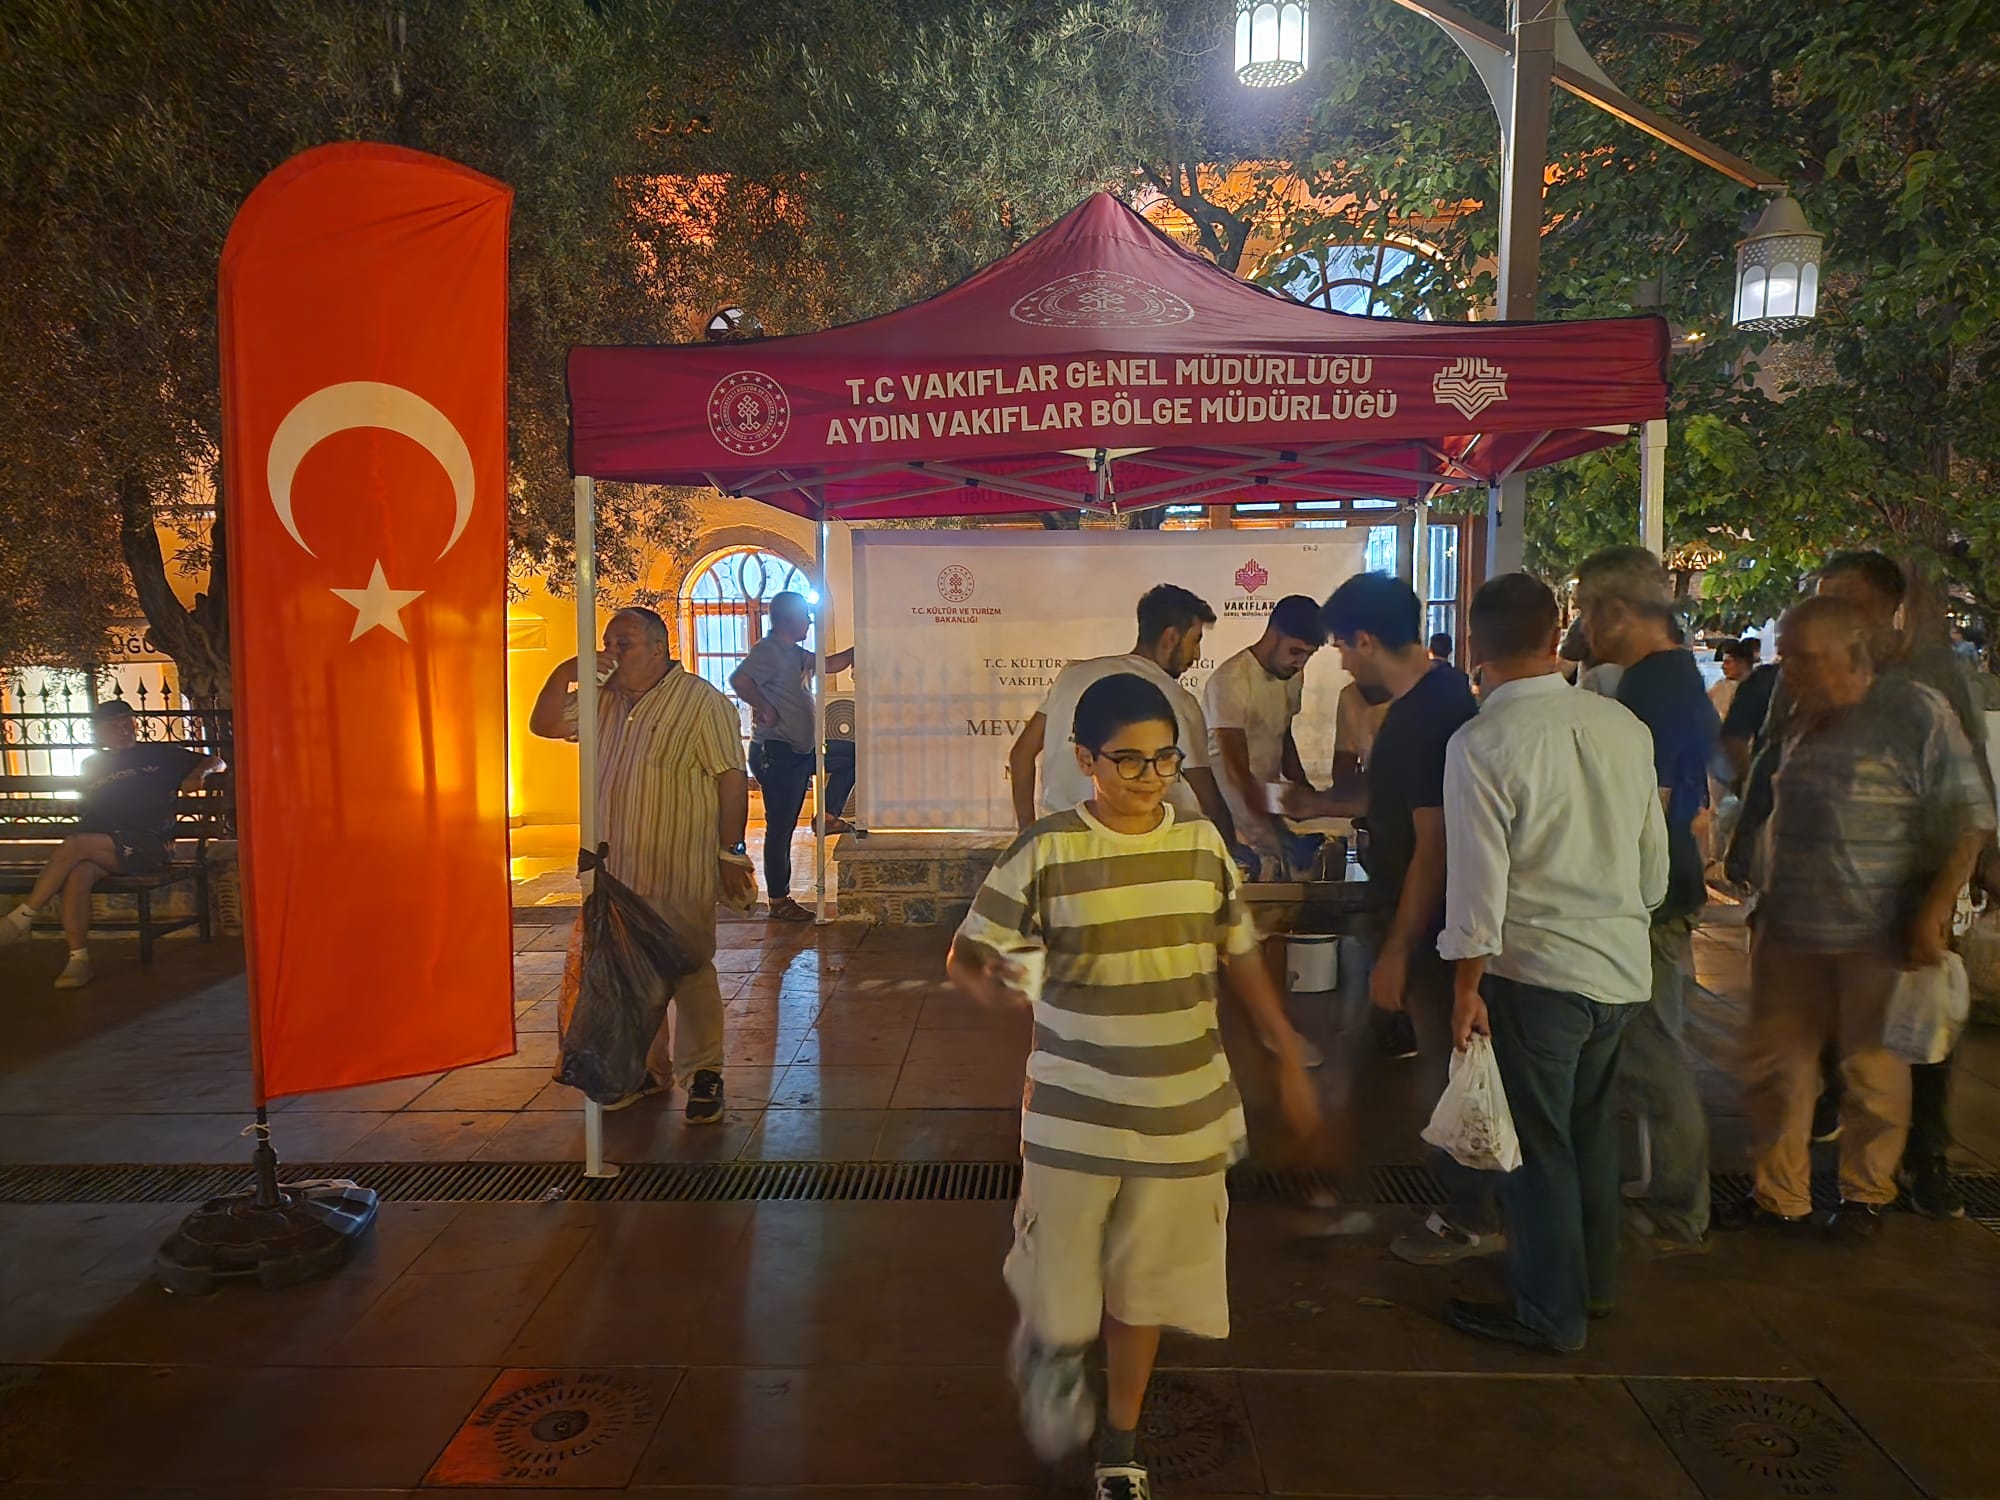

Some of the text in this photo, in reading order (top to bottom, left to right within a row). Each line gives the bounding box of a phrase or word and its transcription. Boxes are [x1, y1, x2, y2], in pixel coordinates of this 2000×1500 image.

[845, 377, 895, 405] T.C
[901, 365, 1058, 401] VAKIFLAR
[1066, 359, 1168, 389] GENEL
[826, 388, 1397, 445] AYDIN VAKIFLAR BÖLGE MÜDÜRLÜĞÜ
[927, 606, 957, 615] KÜLTÜR
[960, 607, 969, 615] VE
[970, 606, 1001, 615] TURİZM
[1224, 601, 1275, 611] VAKIFLAR
[935, 615, 978, 624] BAKANLIĞI
[983, 658, 1007, 668] T.C.
[1010, 657, 1063, 669] KÜLTÜR
[999, 676, 1055, 686] VAKIFLA
